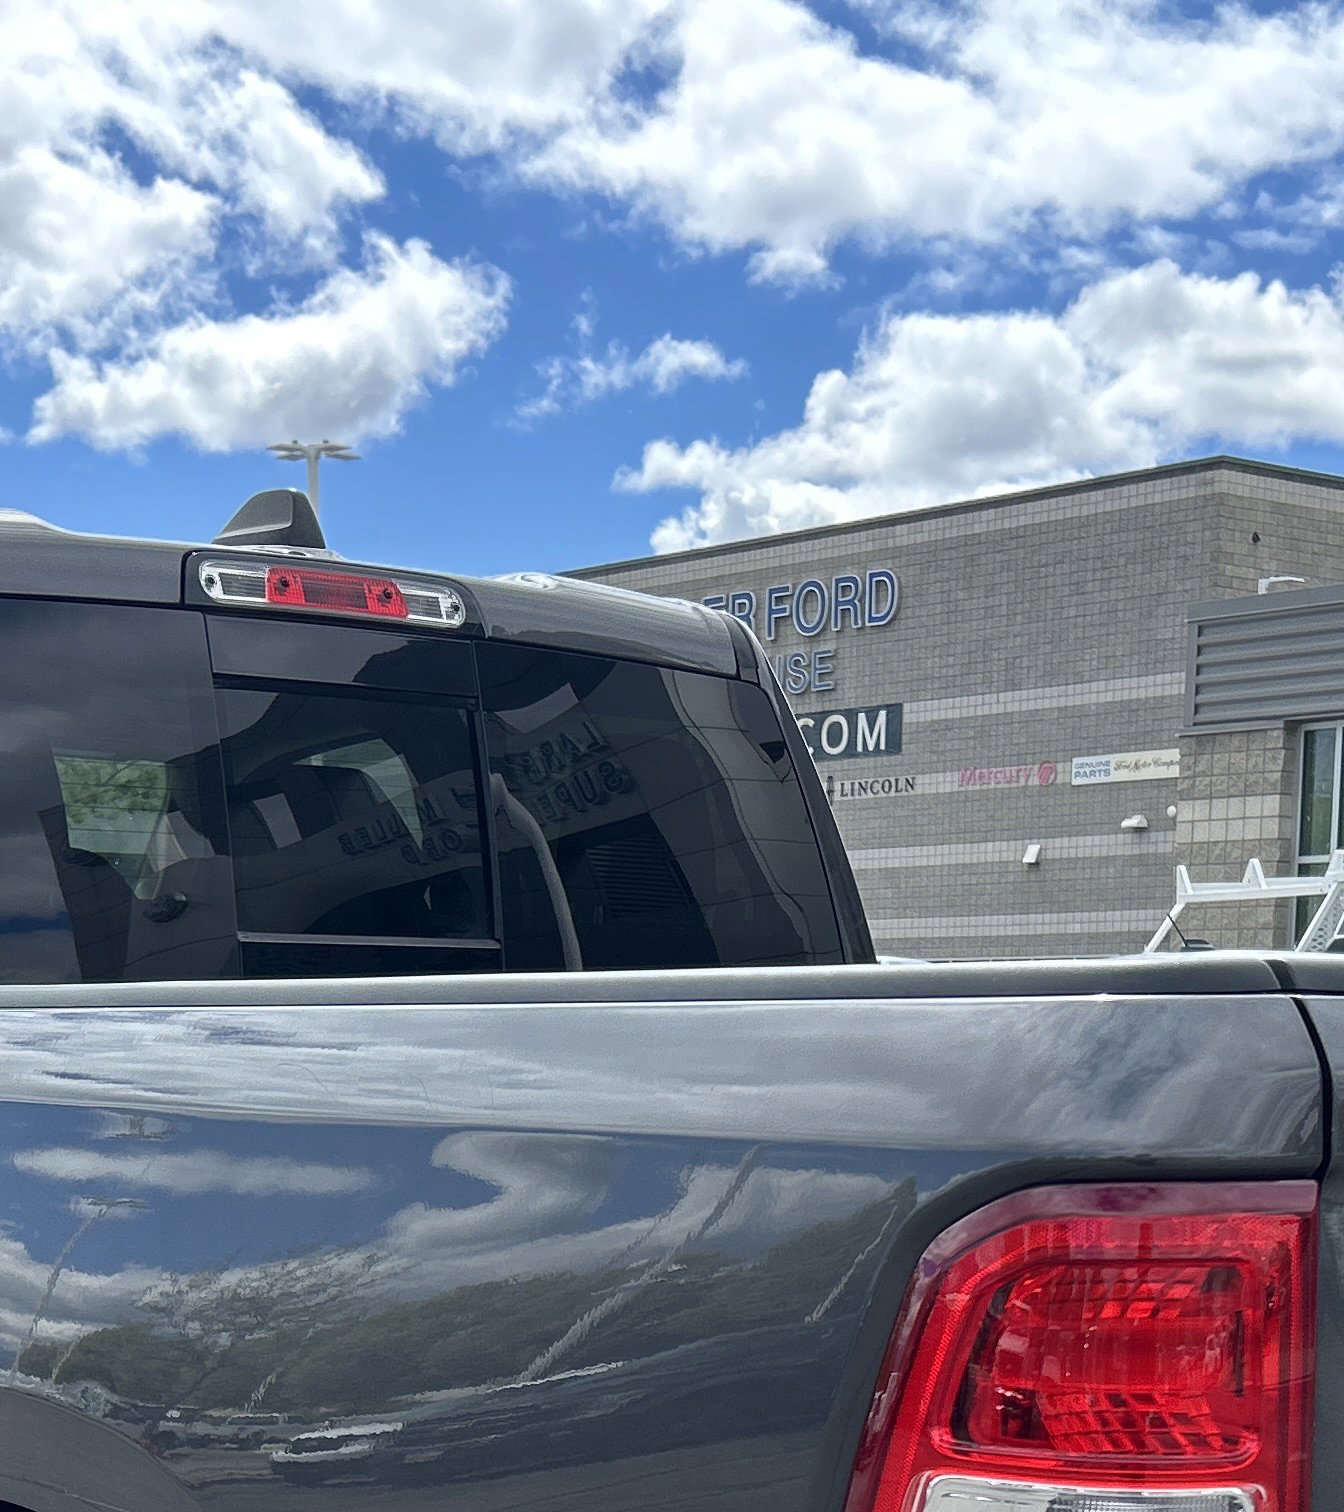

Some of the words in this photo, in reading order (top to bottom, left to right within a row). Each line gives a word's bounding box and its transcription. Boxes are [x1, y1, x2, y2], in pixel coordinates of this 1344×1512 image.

[765, 569, 899, 640] FORD
[1074, 760, 1111, 770] GENUINE
[1074, 769, 1111, 780] PARTS
[958, 765, 1033, 788] Mercury
[840, 777, 916, 797] LINCOLN
